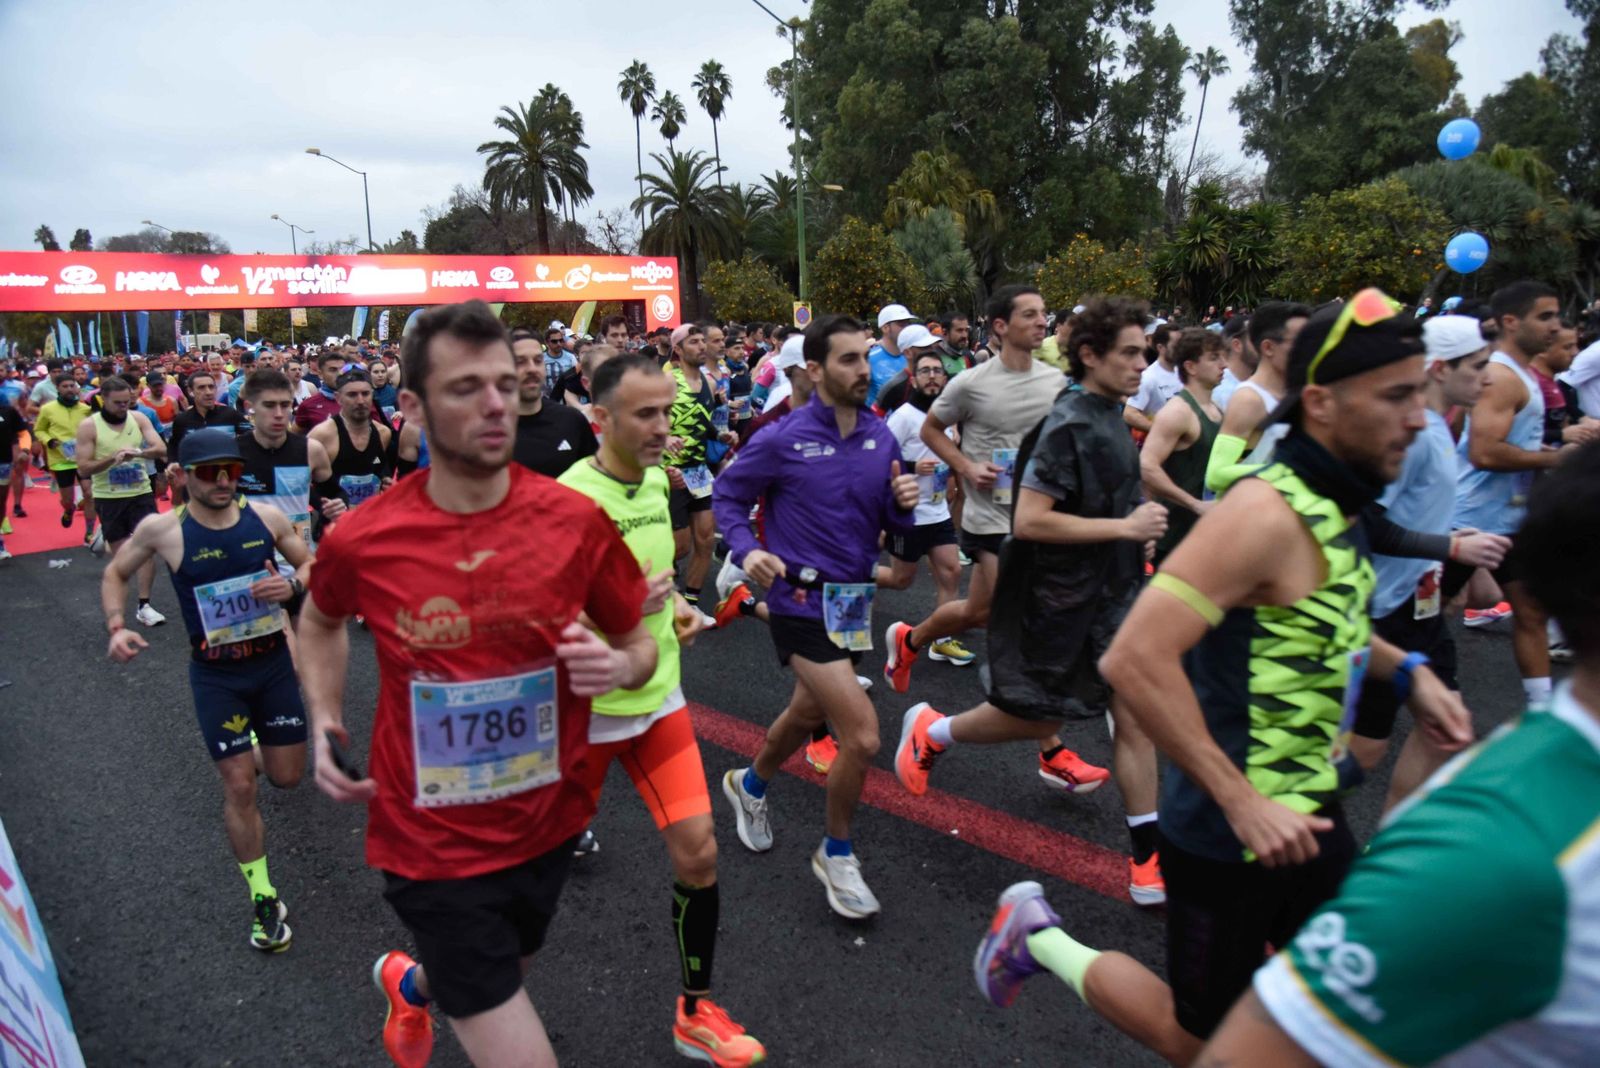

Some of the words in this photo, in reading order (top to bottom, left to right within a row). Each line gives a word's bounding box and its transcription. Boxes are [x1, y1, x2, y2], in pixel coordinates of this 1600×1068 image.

[115, 271, 181, 291] HOKA
[265, 264, 347, 281] maratón
[432, 270, 480, 287] HOKA
[438, 706, 528, 748] 1786
